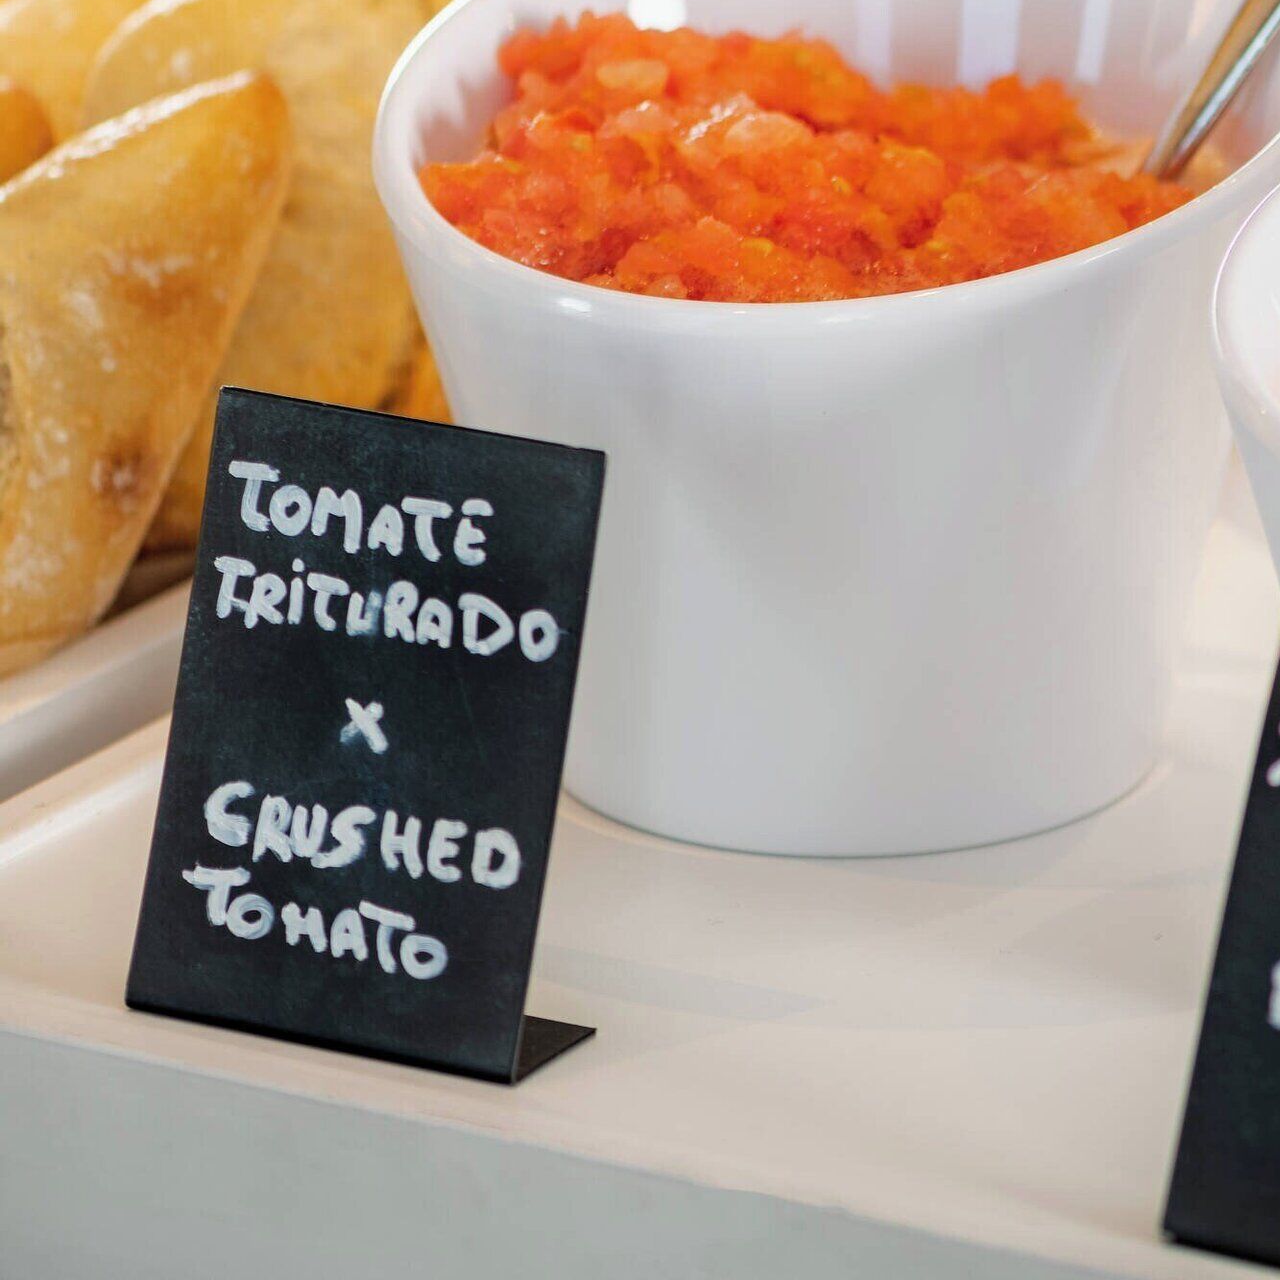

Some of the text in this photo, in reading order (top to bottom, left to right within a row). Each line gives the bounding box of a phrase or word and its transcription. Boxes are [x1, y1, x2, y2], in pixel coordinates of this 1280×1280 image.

[229, 461, 494, 565] TOMATE
[204, 780, 521, 890] CRUSHED
[182, 866, 448, 980] TOMATO
